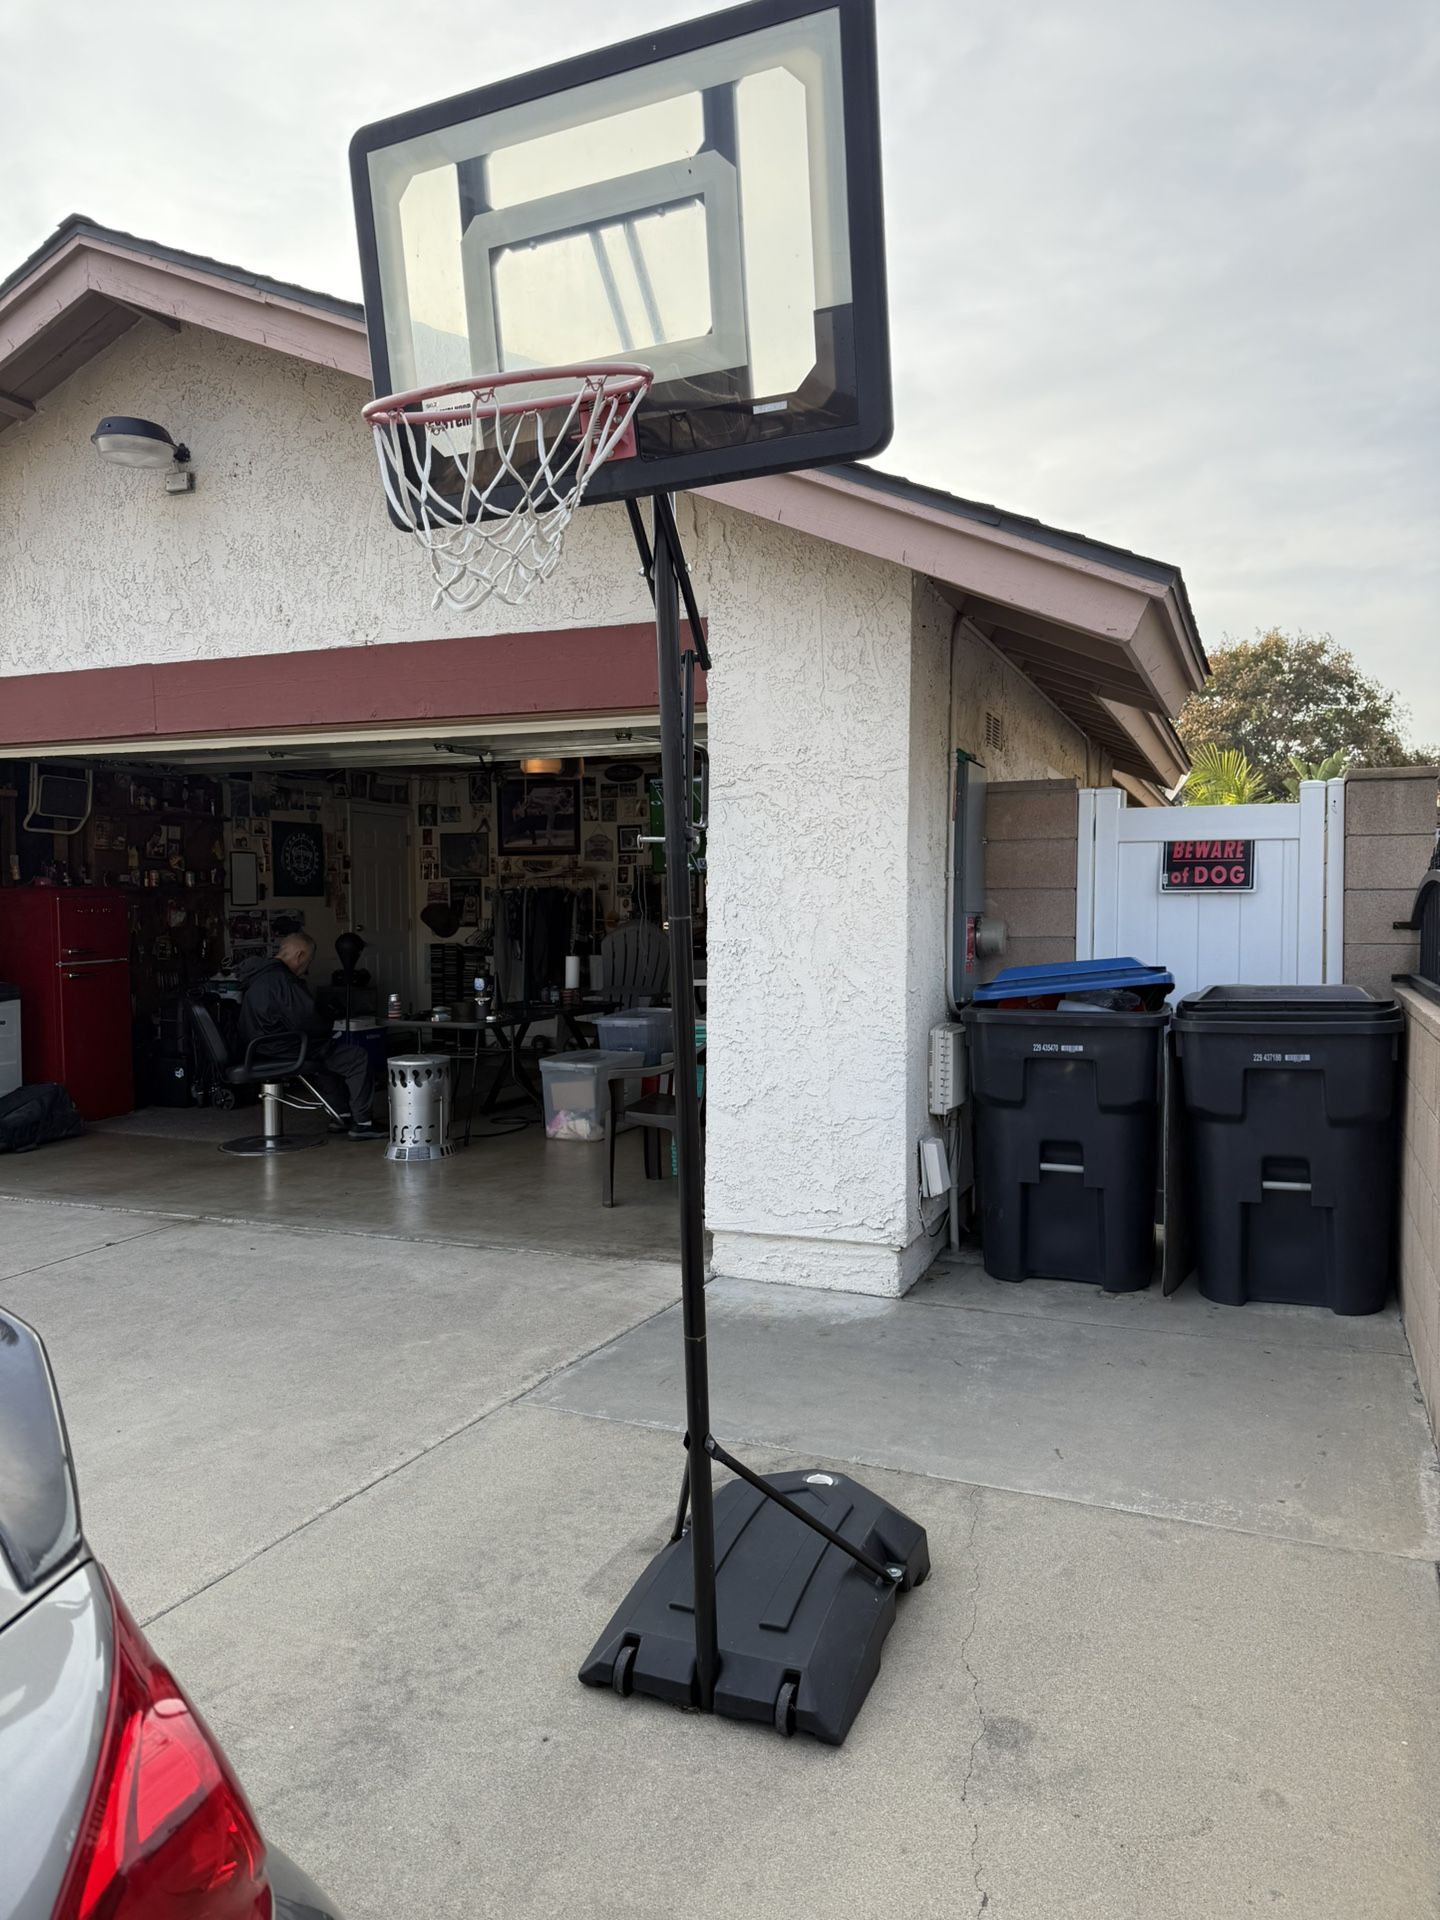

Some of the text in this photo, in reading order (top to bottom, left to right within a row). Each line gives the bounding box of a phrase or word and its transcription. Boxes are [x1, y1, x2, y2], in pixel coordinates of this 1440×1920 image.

[1173, 840, 1244, 858] BEWARE
[1171, 867, 1189, 884] of
[1194, 866, 1245, 884] DOG
